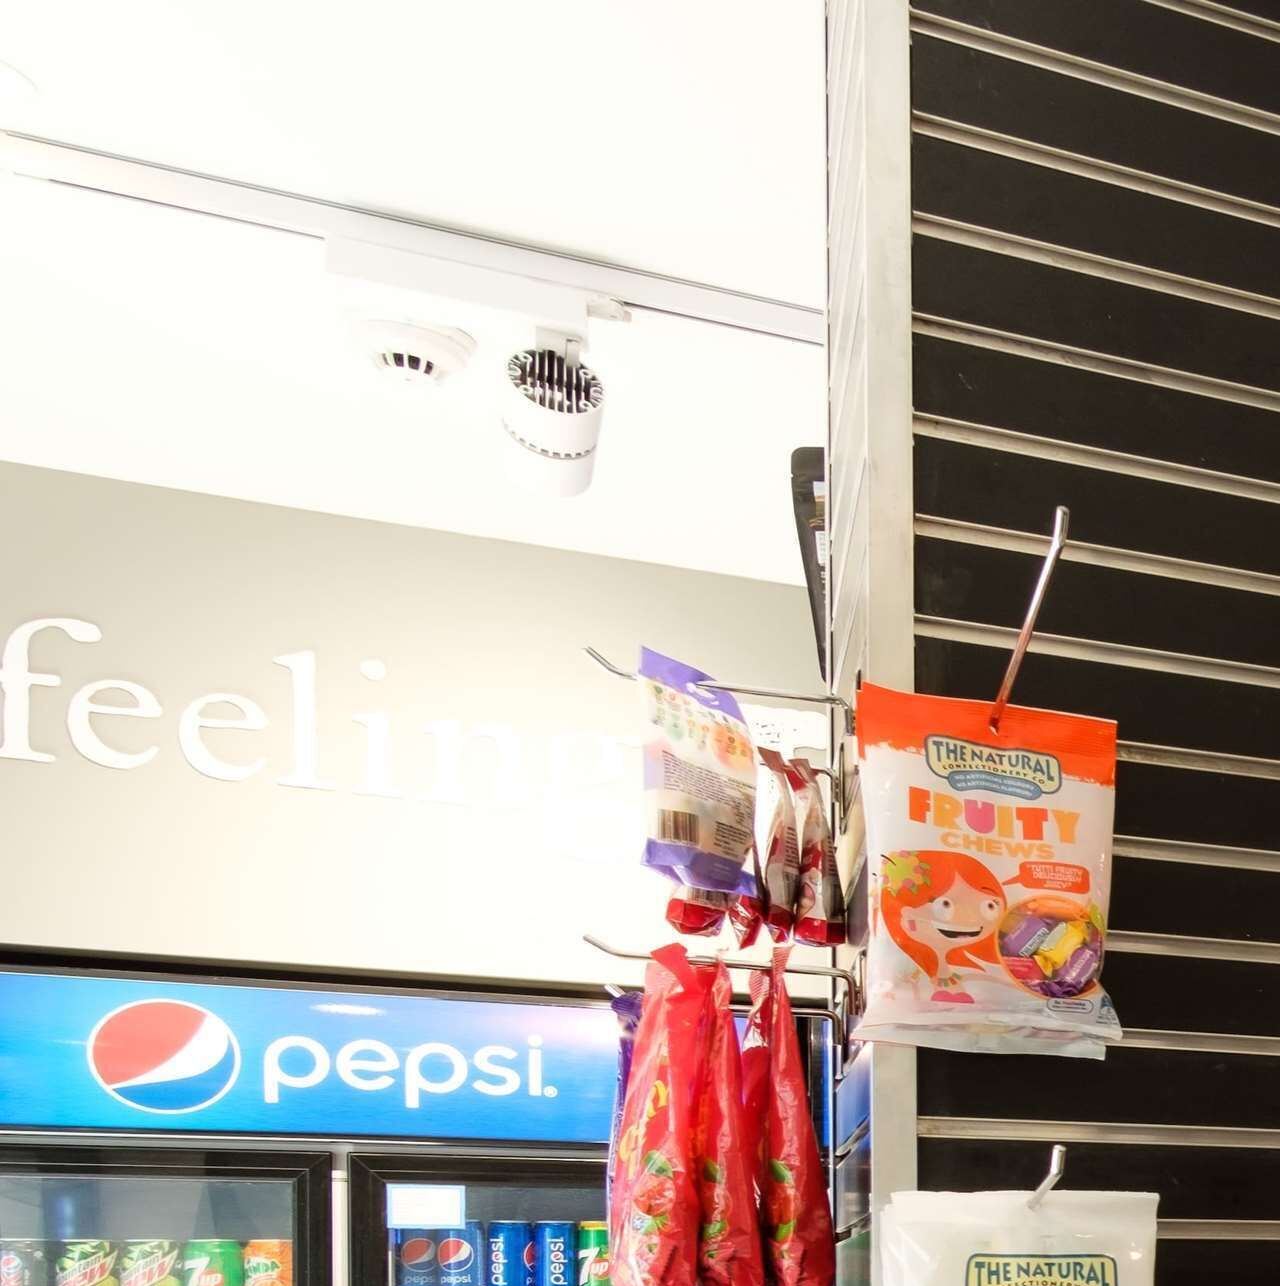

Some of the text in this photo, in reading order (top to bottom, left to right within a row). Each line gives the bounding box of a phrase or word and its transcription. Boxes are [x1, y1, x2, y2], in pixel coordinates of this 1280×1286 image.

[932, 740, 1054, 782] THE NATURAL
[908, 786, 1081, 845] FRUITY
[940, 831, 1054, 860] CHEWS
[263, 1034, 543, 1108] pepsi
[490, 1233, 506, 1286] pepsi
[550, 1236, 567, 1285] pepsi
